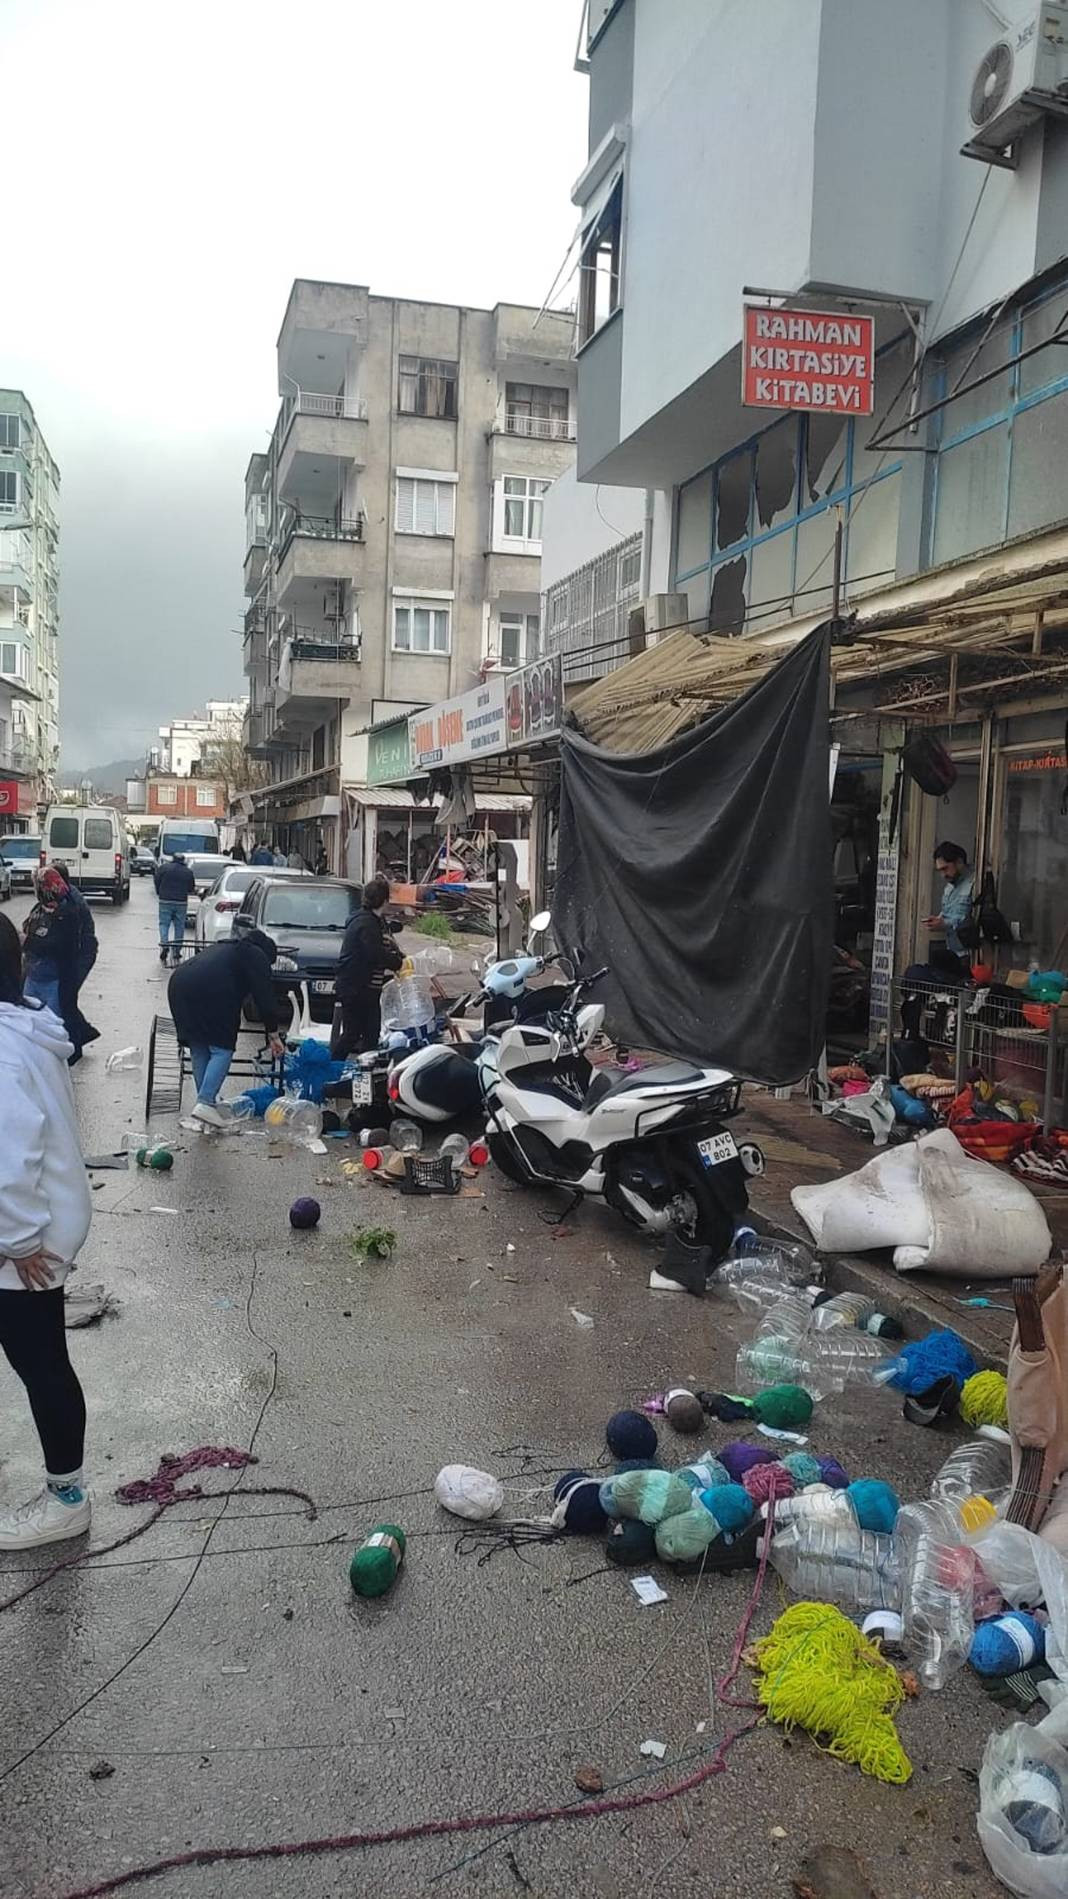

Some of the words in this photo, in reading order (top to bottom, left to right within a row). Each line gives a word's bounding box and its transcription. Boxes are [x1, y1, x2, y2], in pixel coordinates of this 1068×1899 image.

[756, 314, 861, 346] RAHMAN
[700, 1141, 711, 1152] 07
[714, 1134, 732, 1148] AVC
[713, 1147, 731, 1160] 802
